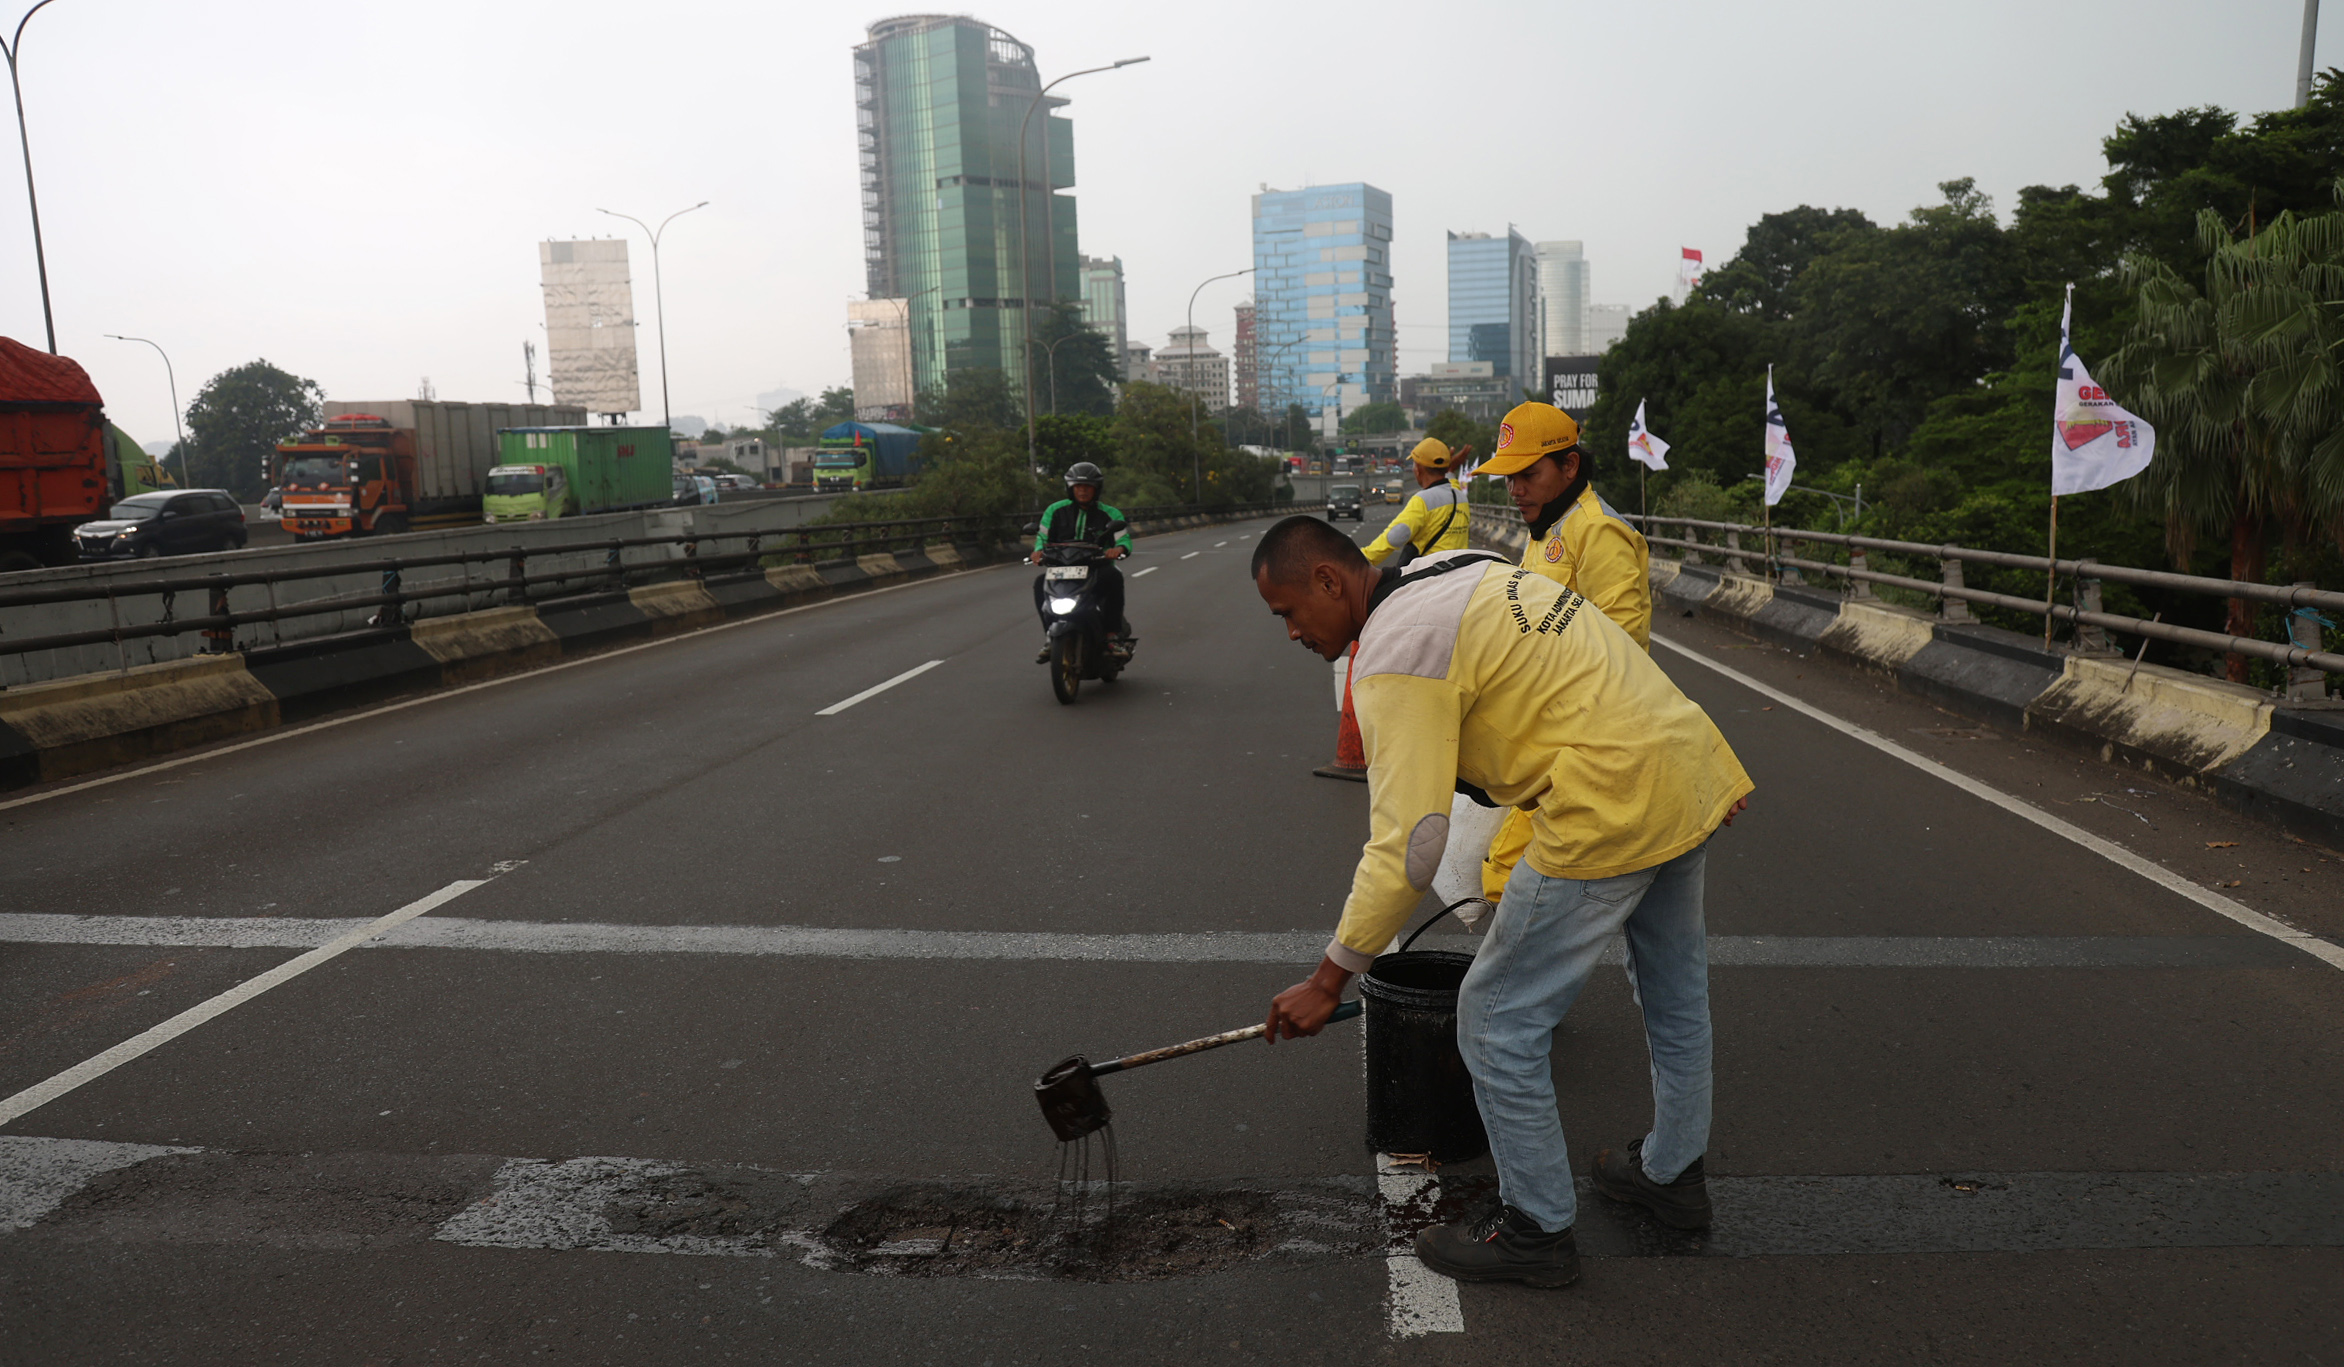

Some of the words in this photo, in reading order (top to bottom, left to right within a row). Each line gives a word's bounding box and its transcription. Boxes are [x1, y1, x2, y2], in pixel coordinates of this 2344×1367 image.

[1553, 374, 1578, 388] PRAY
[1580, 373, 1598, 388] FOR
[1553, 389, 1600, 409] SUMA
[1506, 580, 1519, 601] DINAS
[1510, 604, 1531, 634] SUKU
[1536, 612, 1557, 635] KOTA
[1552, 607, 1578, 636] JAKARTA
